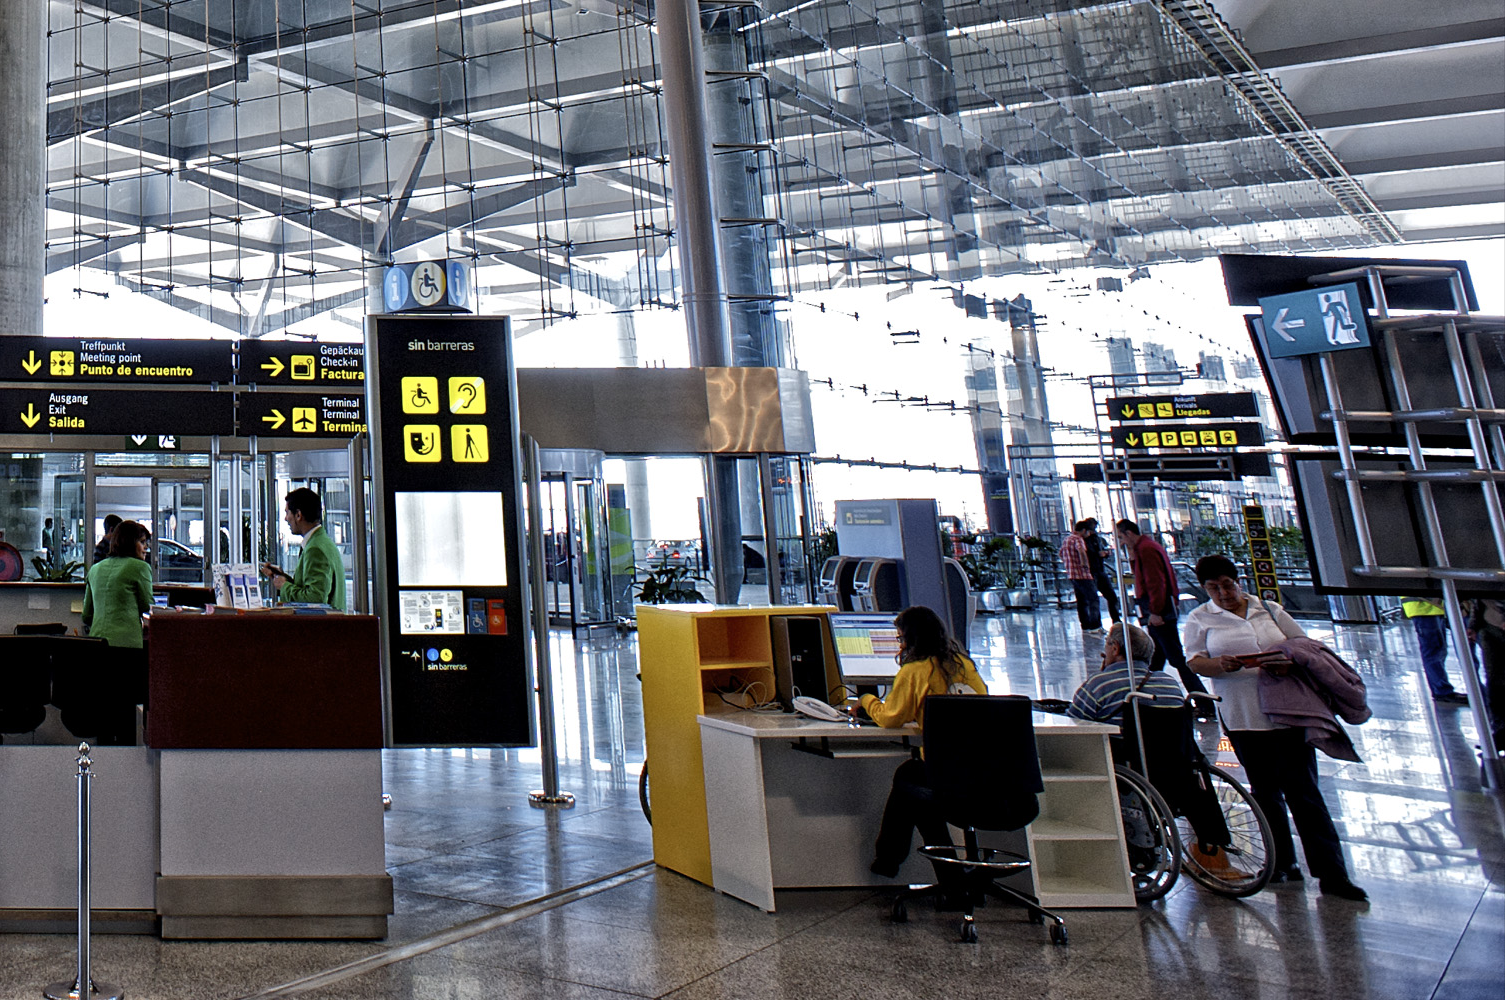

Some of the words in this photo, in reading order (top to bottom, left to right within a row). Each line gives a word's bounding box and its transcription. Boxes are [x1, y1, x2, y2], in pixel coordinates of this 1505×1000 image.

[80, 340, 126, 352] Treffpunkt
[320, 344, 364, 357] Gepäckau
[408, 339, 426, 351] sin
[427, 339, 475, 351] barreras
[80, 352, 116, 364] Meeting
[118, 353, 142, 364] point
[320, 356, 358, 367] Check-in
[80, 363, 114, 376] Punto
[116, 364, 132, 376] de
[135, 365, 194, 377] encuentro
[320, 368, 365, 380] Factura
[49, 392, 89, 405] Ausgang
[321, 396, 360, 408] Terminal
[48, 404, 66, 415] Exit
[321, 408, 360, 420] Terminal
[1176, 408, 1211, 417] Llegadas
[48, 416, 85, 428] Salida
[427, 662, 439, 671] sin
[439, 662, 468, 671] barreras
